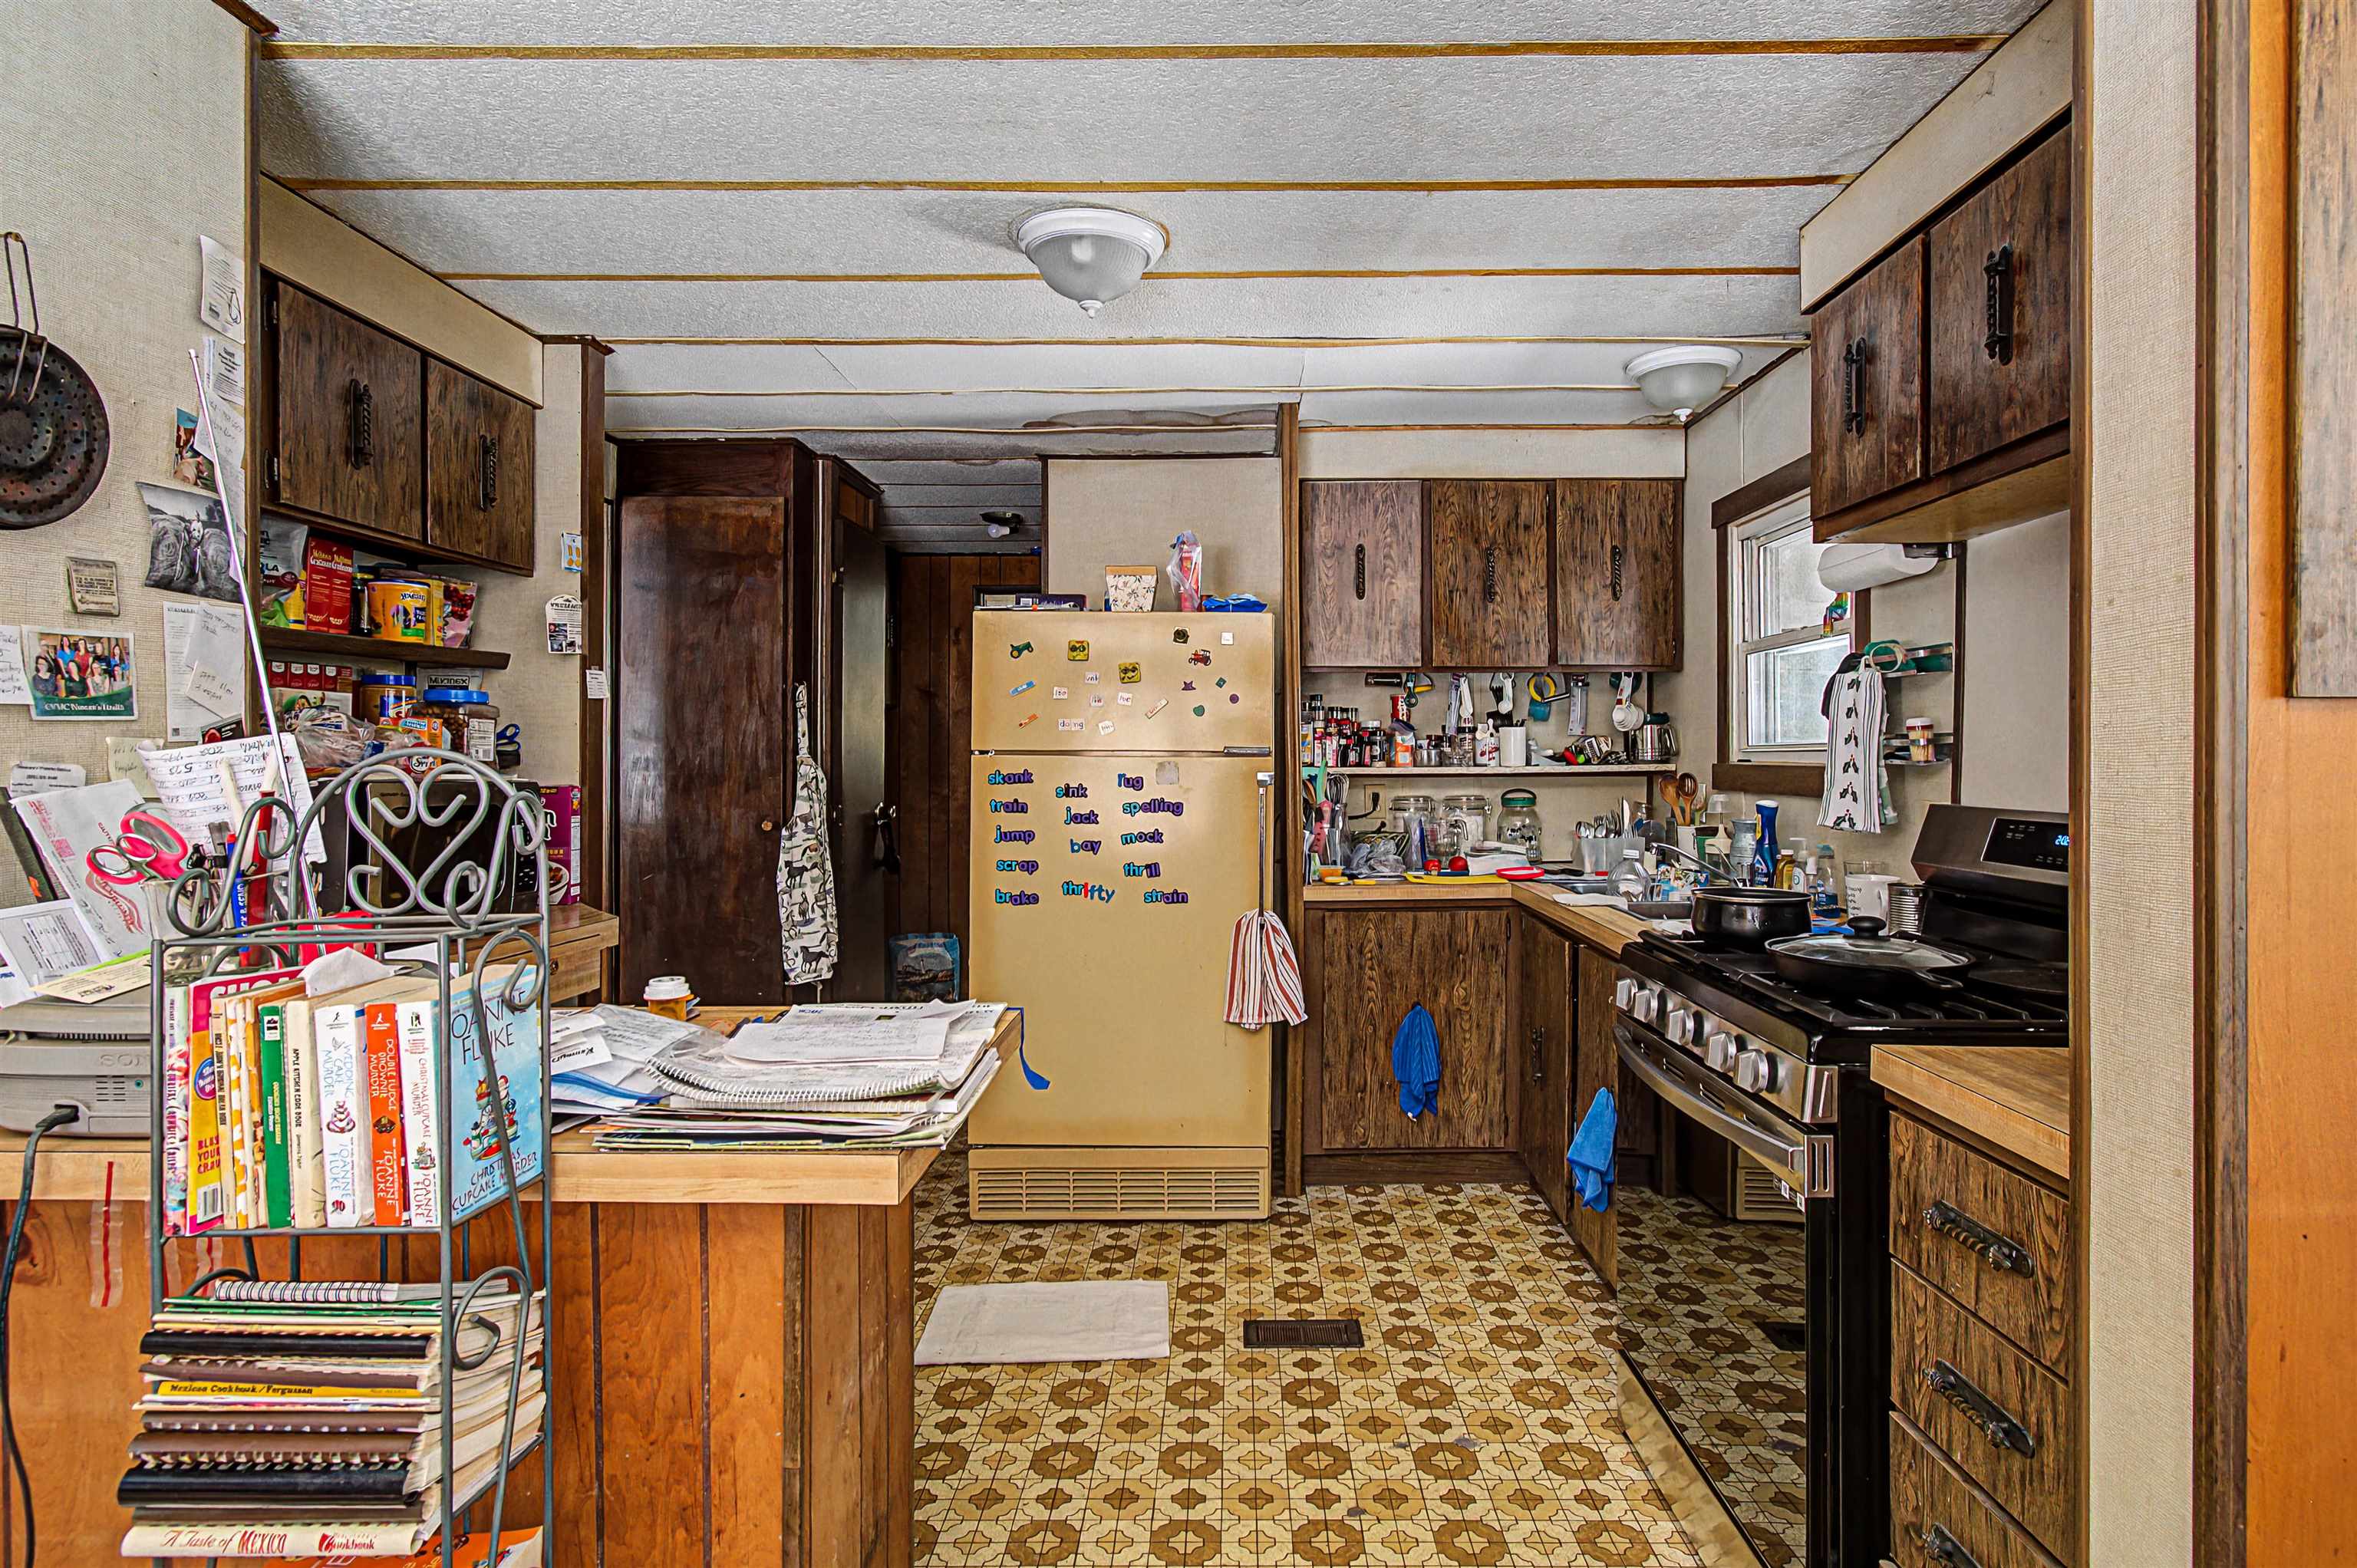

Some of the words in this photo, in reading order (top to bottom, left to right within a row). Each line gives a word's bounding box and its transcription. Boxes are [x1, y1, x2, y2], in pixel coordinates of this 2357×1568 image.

[988, 769, 1033, 785] skank
[1117, 773, 1143, 791] rug
[1056, 784, 1088, 798] sink
[990, 799, 1028, 813] train
[1064, 806, 1099, 825] jack
[1122, 798, 1183, 816] spelling
[994, 825, 1035, 844] jump
[1070, 838, 1102, 855] bay
[1121, 828, 1163, 845] mock
[996, 859, 1039, 875] scrap
[1123, 862, 1161, 878] thrill
[995, 889, 1039, 905] brake
[1062, 881, 1116, 903] thrifty
[1144, 889, 1188, 904] strain
[387, 1039, 396, 1076] DOUBLE
[324, 1050, 335, 1097] MURDER
[334, 1058, 344, 1085] CAKE
[344, 1044, 354, 1098] WEDDING
[370, 1054, 378, 1097] MURDER
[378, 1052, 387, 1099] BROWNIE
[418, 1058, 430, 1103] CHRISTMAS
[387, 1079, 396, 1111] FUDGE
[420, 1103, 431, 1139] CUPCAKE
[329, 1152, 341, 1191] FLUKE
[340, 1144, 351, 1198] JOANNE
[375, 1159, 386, 1198] FLUKE
[384, 1150, 394, 1206] JOANNE
[413, 1181, 424, 1218] FLUKE
[420, 1173, 433, 1224] JOANNE
[170, 1384, 207, 1392] Mexican
[211, 1385, 257, 1394] Cookbook
[265, 1385, 313, 1396] Fergusson
[160, 1530, 183, 1547] A
[181, 1530, 215, 1547] Taste
[216, 1530, 241, 1553] of
[238, 1530, 288, 1554] MEXICO
